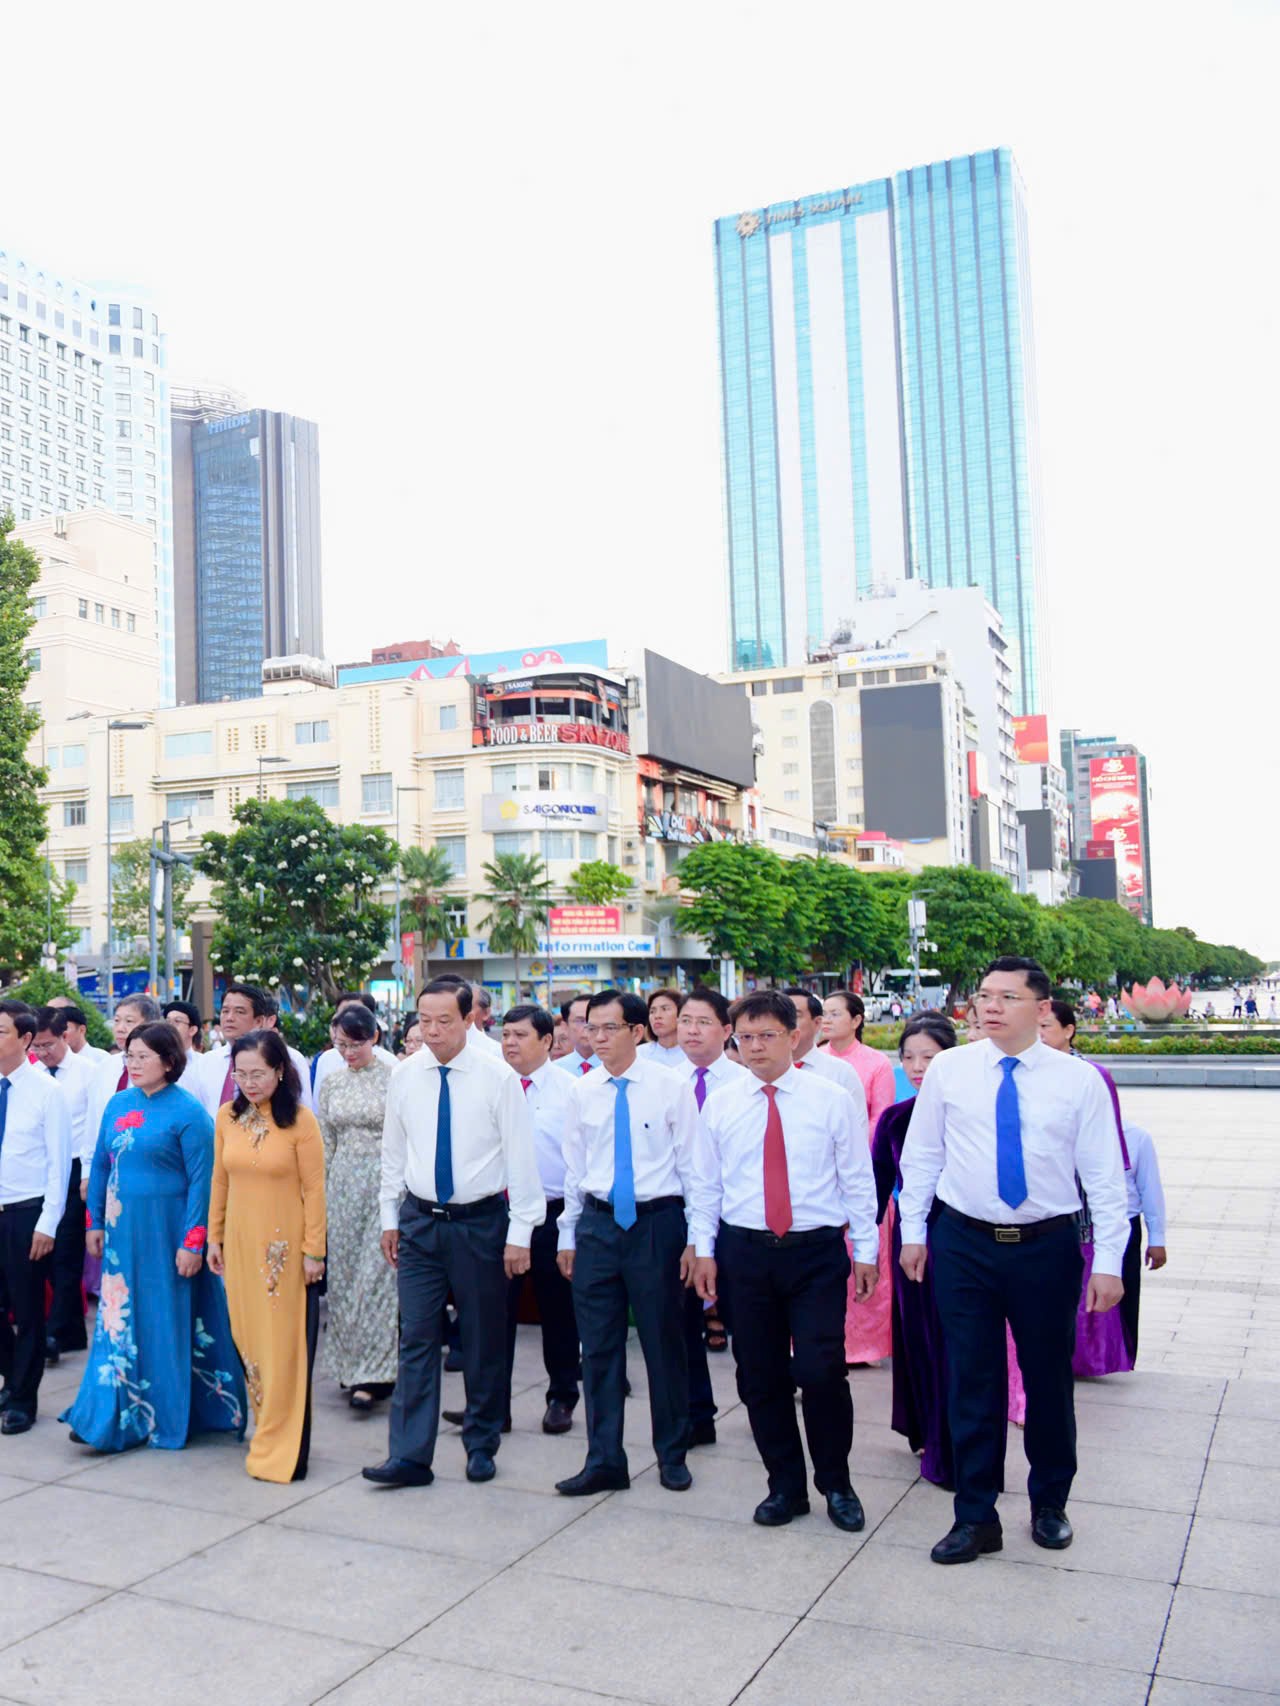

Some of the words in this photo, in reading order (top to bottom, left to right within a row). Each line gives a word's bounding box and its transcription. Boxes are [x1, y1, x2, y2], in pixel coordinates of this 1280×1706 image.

[490, 726, 518, 745] FOOD
[519, 727, 528, 741] &
[529, 723, 558, 743] BEER
[539, 940, 624, 953] Information
